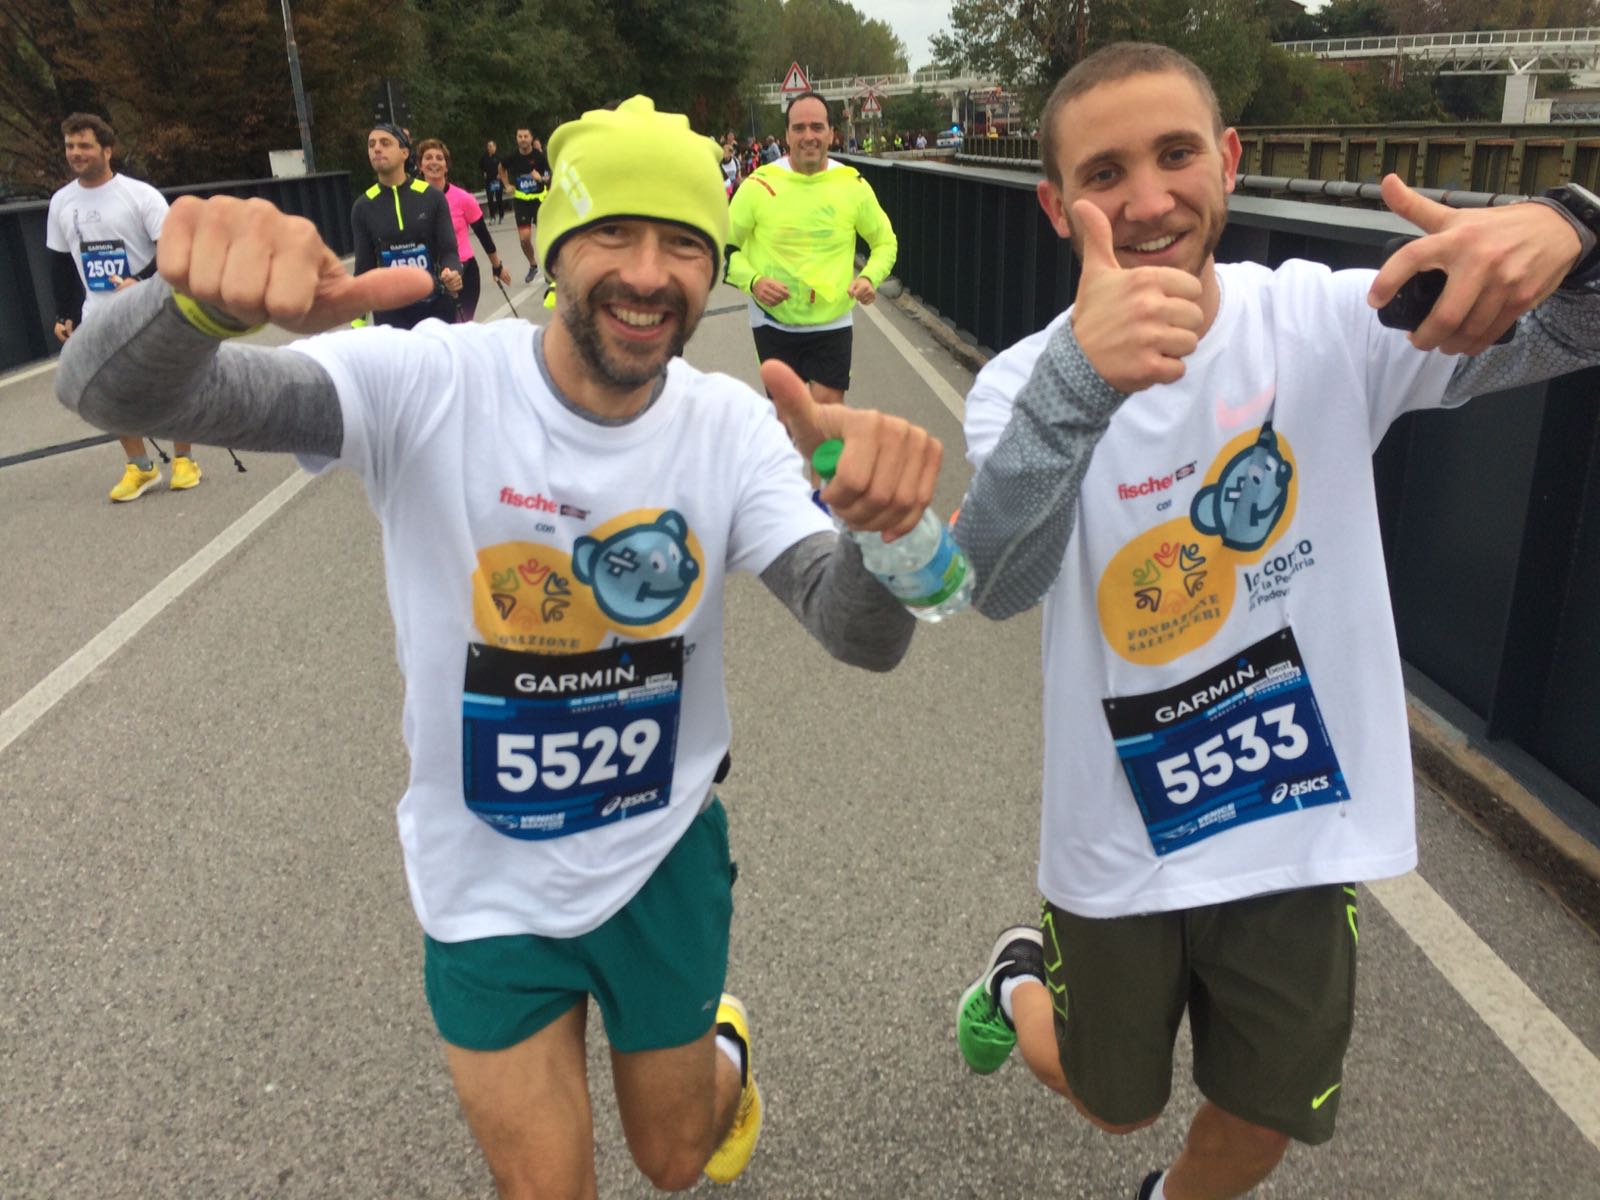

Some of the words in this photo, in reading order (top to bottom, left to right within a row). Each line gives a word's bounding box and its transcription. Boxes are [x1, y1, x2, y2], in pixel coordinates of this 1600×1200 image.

[87, 259, 124, 278] 2507
[534, 522, 555, 534] con
[514, 664, 635, 693] GARMIN
[1155, 664, 1255, 723] GARMIN
[496, 718, 661, 793] 5529
[1156, 702, 1309, 805] 5533
